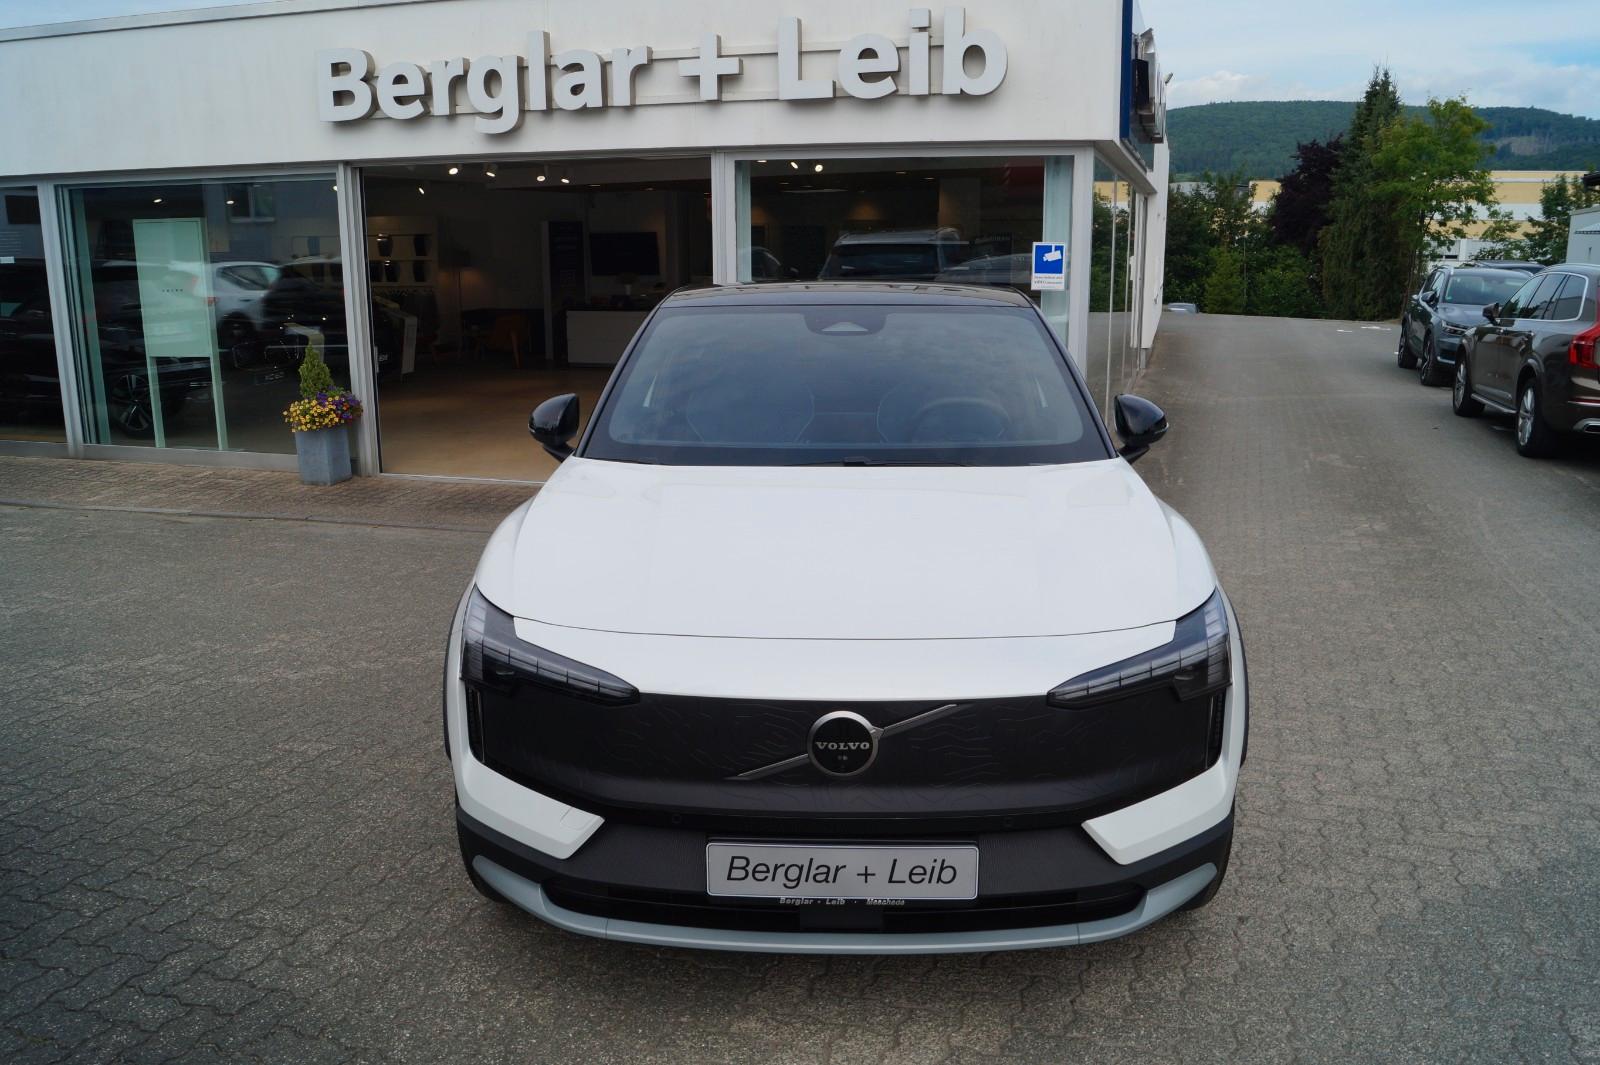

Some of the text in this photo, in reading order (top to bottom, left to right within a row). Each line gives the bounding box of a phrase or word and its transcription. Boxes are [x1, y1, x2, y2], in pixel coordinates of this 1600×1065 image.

[319, 7, 1008, 134] Berglar + Leib
[815, 741, 870, 750] VOLVO
[726, 855, 957, 889] Berglar + Leib
